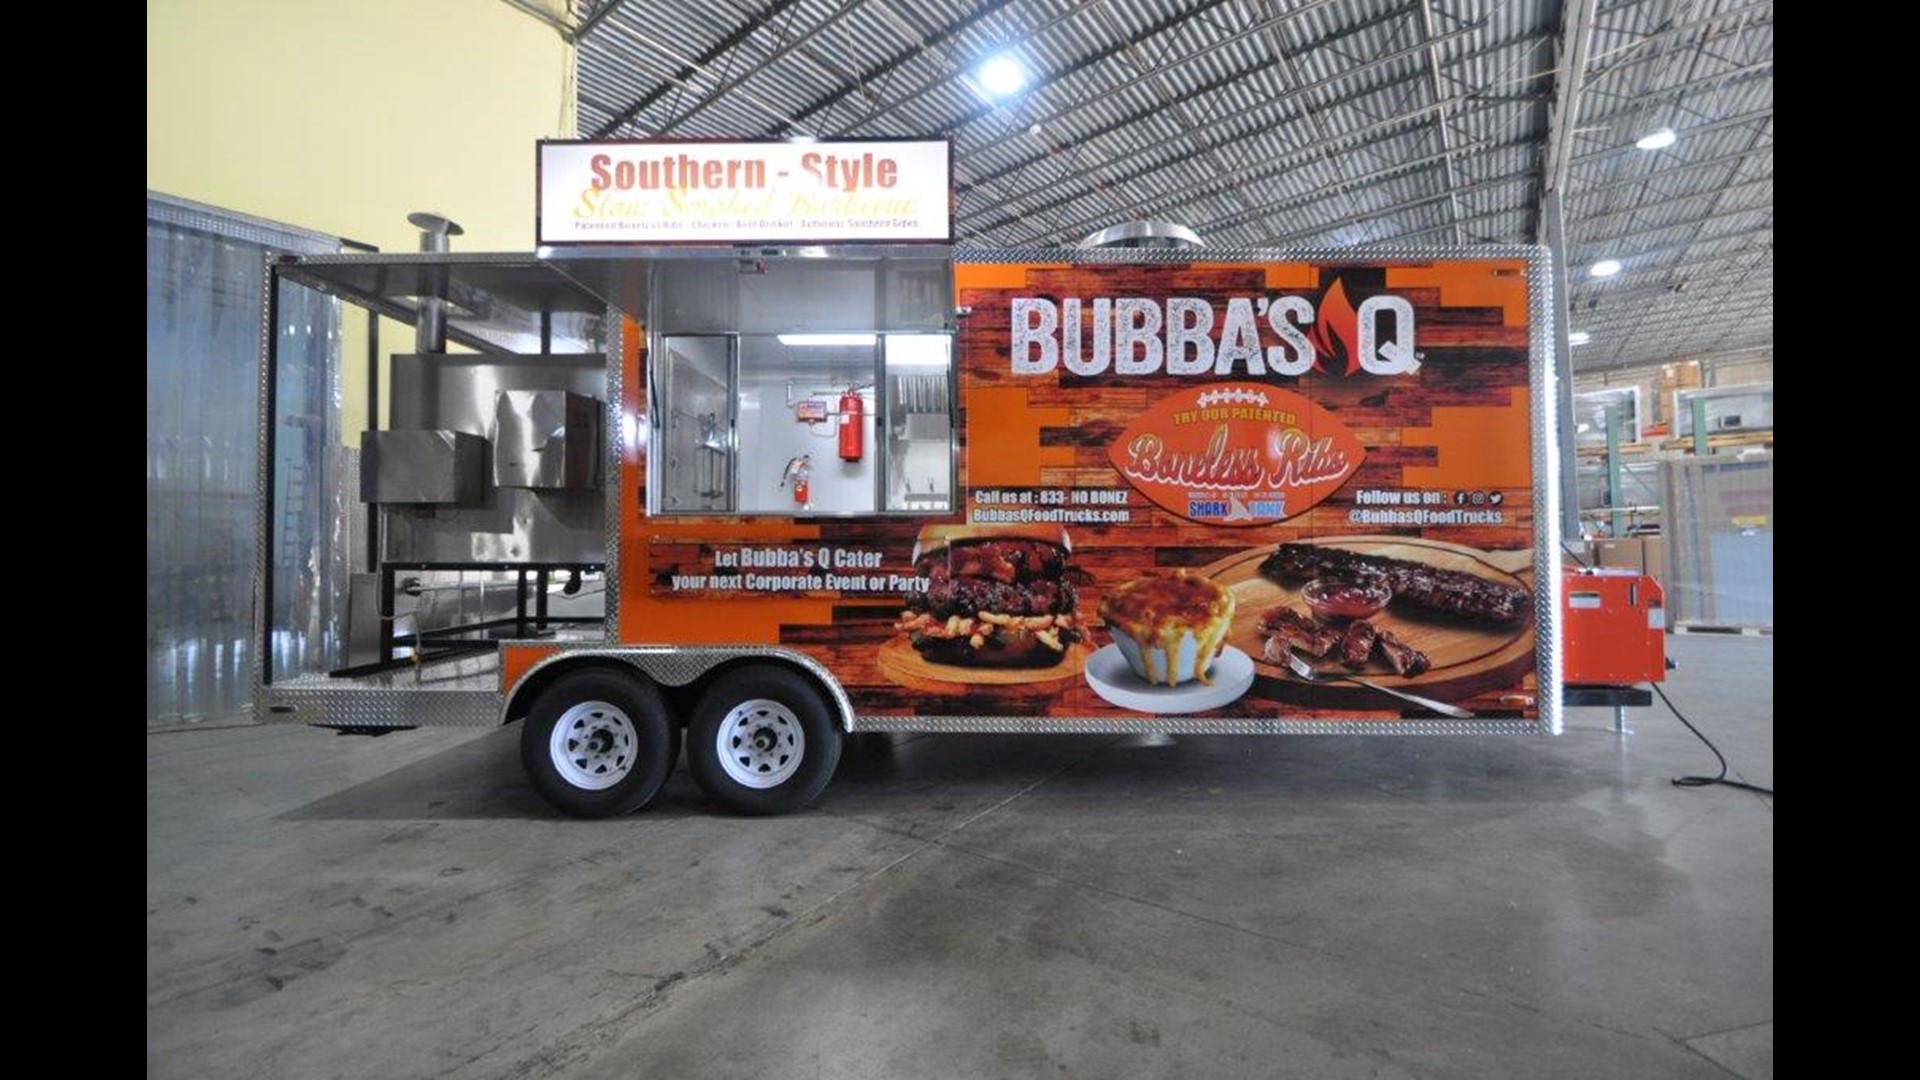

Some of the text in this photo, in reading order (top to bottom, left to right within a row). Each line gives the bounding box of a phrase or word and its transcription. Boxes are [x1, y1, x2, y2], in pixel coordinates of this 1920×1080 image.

[590, 153, 766, 191] Southern
[801, 152, 898, 192] Style
[1010, 295, 1423, 376] BUBBA'S Q
[1173, 408, 1297, 425] TRY OUR PATENTED
[1125, 423, 1350, 490] Boneless Ribs
[975, 490, 999, 504] Call
[1002, 492, 1017, 504] us
[1090, 490, 1128, 504] BONEZ
[1356, 490, 1400, 504] Follow
[1403, 492, 1421, 504] us
[973, 508, 1130, 523] BubbasQFoodTrucks.com
[1189, 501, 1229, 517] SHARK
[1350, 509, 1502, 524] @BubbasQFoodTrucks
[715, 547, 883, 569] Let Bubba's Q Cater
[671, 574, 930, 592] your next Corporate Event or Party
